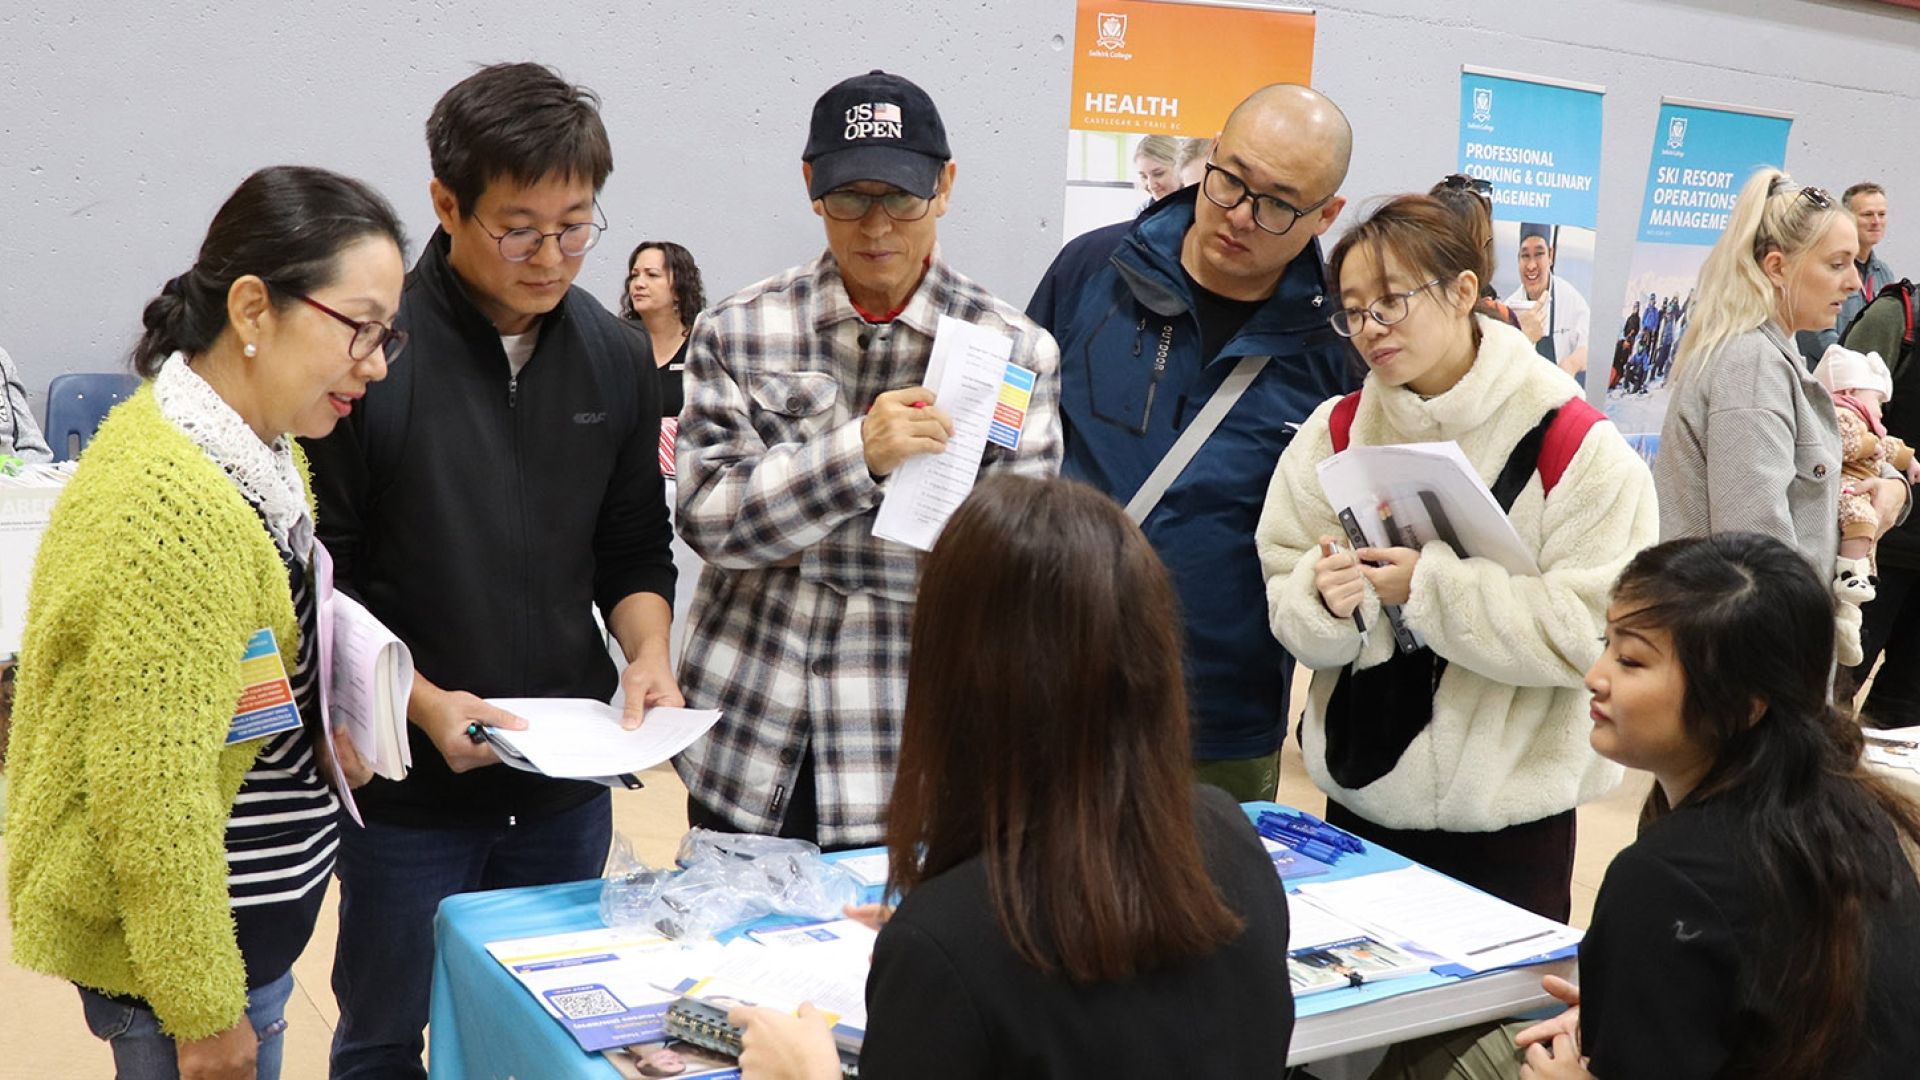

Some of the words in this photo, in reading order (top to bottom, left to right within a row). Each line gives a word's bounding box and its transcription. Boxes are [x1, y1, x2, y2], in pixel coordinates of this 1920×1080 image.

[844, 102, 873, 124] US
[1084, 91, 1179, 118] HEALTH
[844, 120, 903, 141] OPEN
[1465, 142, 1555, 168] PROFESSIONAL
[1464, 163, 1521, 185] COOKING
[1524, 169, 1534, 186] &
[1535, 171, 1593, 193] CULINARY
[1656, 166, 1680, 185] SKI
[1682, 168, 1734, 189] RESORT
[1491, 186, 1552, 208] AGEMENT
[1653, 187, 1738, 211] OPERATIONS
[1648, 208, 1730, 231] MANAGEME
[1154, 324, 1173, 371] OUTDOOR
